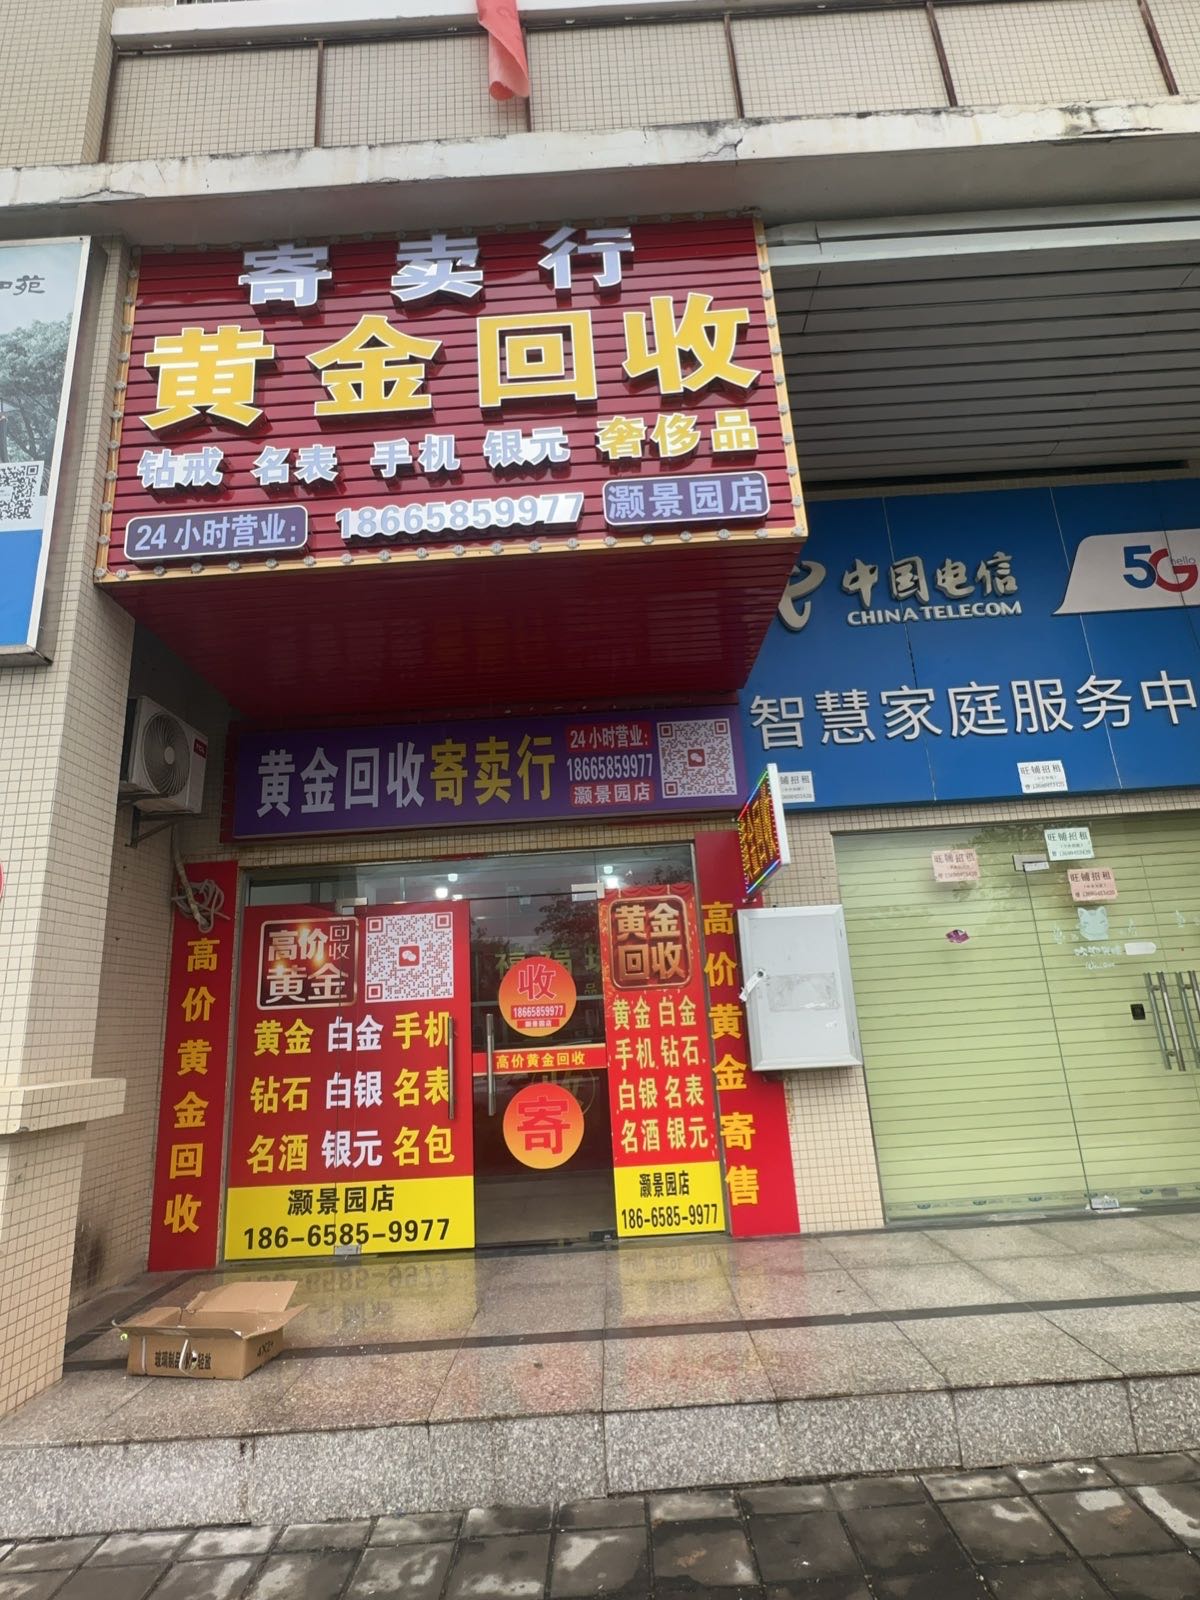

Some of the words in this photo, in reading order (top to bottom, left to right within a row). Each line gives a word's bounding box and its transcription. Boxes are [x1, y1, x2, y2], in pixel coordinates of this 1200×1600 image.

[238, 226, 635, 307] 寄卖行
[139, 292, 761, 431] 黄金回收
[137, 446, 224, 489] 钻戒
[252, 445, 338, 485] 名表
[370, 433, 460, 479] 手机
[483, 426, 571, 469] 银元
[596, 408, 759, 460] 奢侈品
[335, 492, 584, 539] 18665859977
[608, 476, 764, 521] 灏景园店
[842, 551, 1018, 608] 中国电信
[1123, 545, 1198, 593] 5G
[847, 607, 919, 626] CHINA
[919, 600, 1022, 619] TELECOM
[750, 670, 1198, 750] 智慧家庭服务中
[566, 753, 653, 782] 18665859977
[780, 775, 810, 784] 铺招租
[615, 902, 681, 940] 黄金
[268, 927, 328, 961] 高价
[328, 925, 350, 960] 回收
[618, 941, 686, 980] 回收
[265, 963, 349, 1004] 黄金
[517, 963, 557, 1000] 收
[513, 1005, 563, 1018] 18665859977
[613, 996, 651, 1031] 黄金
[658, 995, 697, 1028] 白金
[254, 1018, 314, 1056] 黄金
[327, 1014, 383, 1053] 白金
[392, 1011, 452, 1049] 手机
[615, 1037, 656, 1070] 手机
[660, 1035, 699, 1067] 钻石
[496, 1051, 585, 1069] 高价黄金回收
[702, 902, 760, 1206] 高价黄金寄售
[164, 938, 221, 1234] 高价黄金回收
[250, 1075, 312, 1114] 钻石
[325, 1070, 383, 1110] 白银
[392, 1066, 450, 1107] 名表
[618, 1078, 657, 1111] 白银
[664, 1075, 704, 1108] 名表
[517, 1096, 570, 1154] 寄
[621, 1118, 660, 1153] 名酒
[666, 1116, 708, 1150] 银元
[247, 1134, 308, 1174] 名酒
[322, 1130, 382, 1168] 银元
[392, 1125, 455, 1166] 名包
[287, 1185, 395, 1216] 灏景园店
[621, 1203, 718, 1231] 186-6585-9977
[243, 1218, 450, 1251] 186-6585-9977
